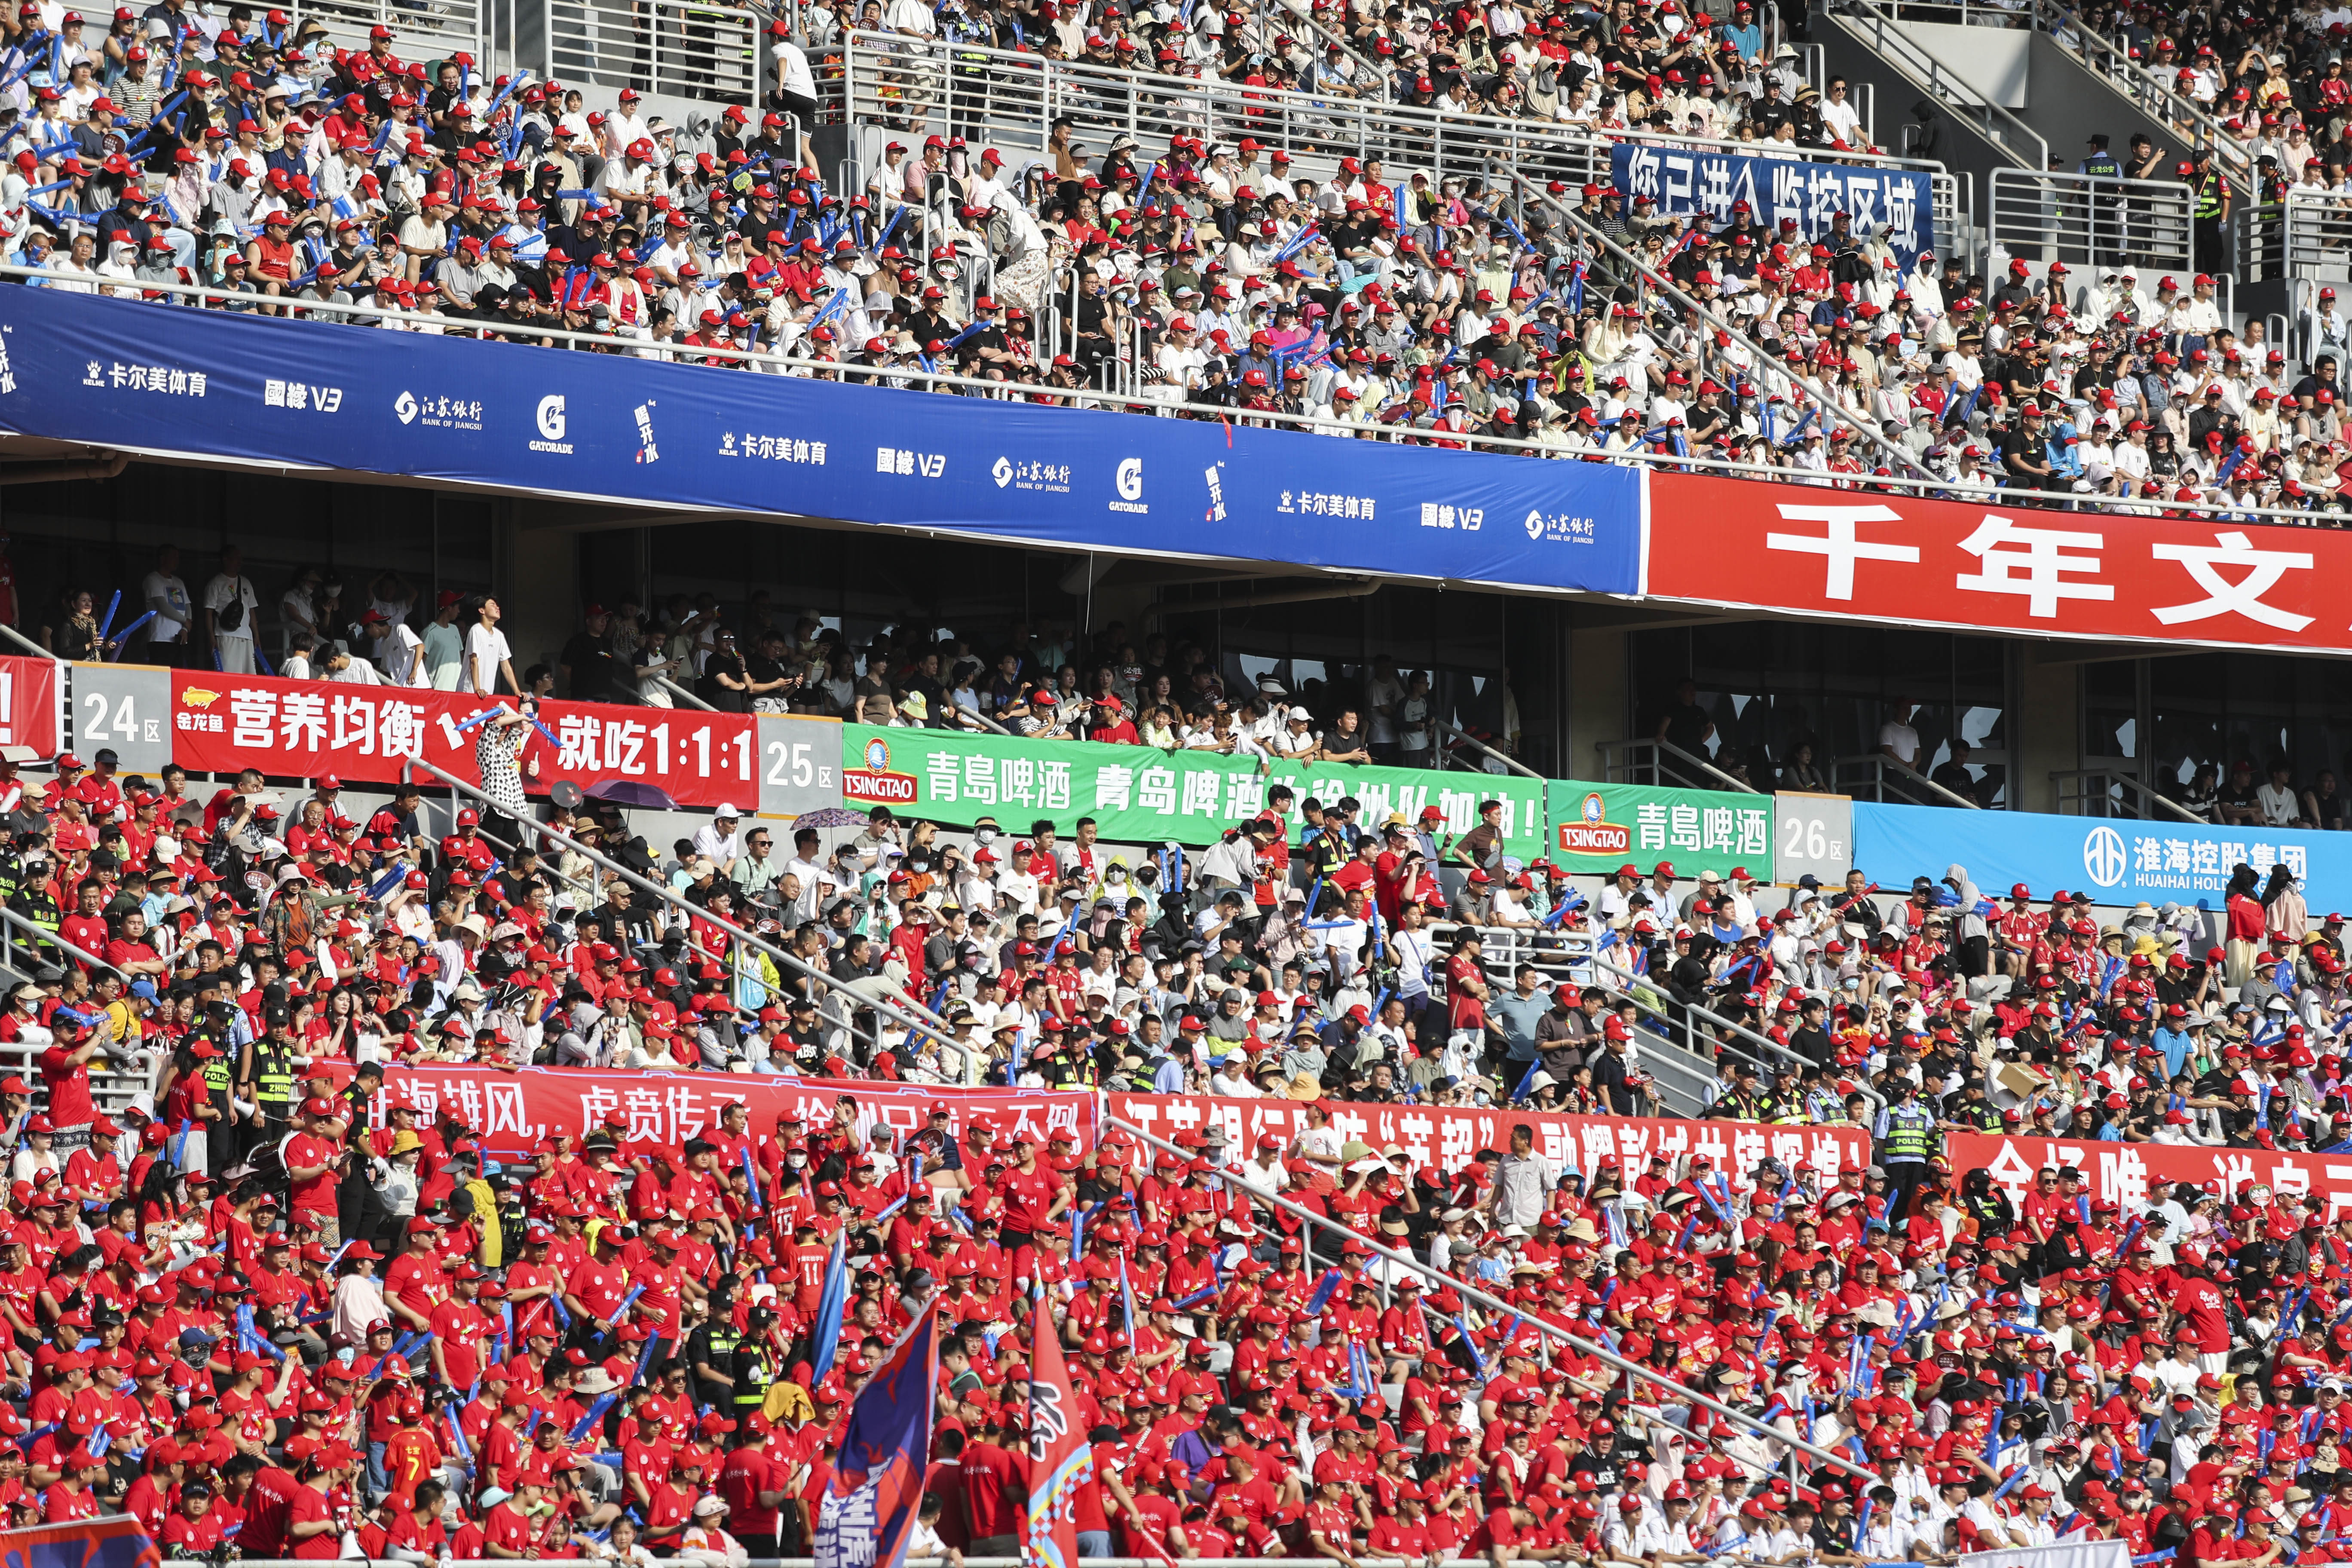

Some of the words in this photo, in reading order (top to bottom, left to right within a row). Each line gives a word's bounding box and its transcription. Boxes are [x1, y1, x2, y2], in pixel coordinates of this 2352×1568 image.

[1168, 35, 1185, 44] 必胜
[317, 45, 335, 55] 必胜
[678, 159, 695, 167] 必胜
[939, 265, 957, 274] 必胜
[0, 330, 17, 394] 开水
[2061, 364, 2075, 372] 必胜
[83, 379, 105, 387] KELME
[108, 362, 207, 397] 卡尔美体育
[311, 386, 343, 413] V3
[422, 395, 483, 421] 江苏银行
[422, 418, 441, 426] BANK
[455, 421, 482, 431] JIANGSU
[634, 404, 659, 464] 喝开水
[529, 440, 573, 454] GATORADE
[719, 449, 738, 457] KELME
[741, 433, 827, 466] 卡尔美体育
[918, 453, 946, 478] V3
[1016, 461, 1071, 485] 江苏银行
[1045, 484, 1070, 493] JIANGSU
[1205, 466, 1227, 522] 喝开水
[1109, 501, 1148, 514] GATORADE
[1297, 491, 1375, 521] 卡尔美体育
[1459, 508, 1484, 531] V3
[1547, 514, 1595, 537] 江苏银行
[1573, 536, 1594, 545] JIANGSU
[1767, 503, 2352, 632] 千年文
[176, 712, 224, 733] 金龙鱼
[230, 688, 425, 758] 营养均衡
[844, 774, 913, 799] TSINGTAO
[1636, 802, 1767, 855] 青島啤酒
[1562, 828, 1626, 849] TSINGTAO
[2133, 836, 2307, 881] 淮海控股集团
[2135, 873, 2190, 889] HUAIHAI
[1059, 989, 1075, 1000] 徐州
[205, 1072, 230, 1082] POLIC
[1896, 1119, 1923, 1129] 警察
[1896, 1137, 1924, 1146] POLICE
[2250, 1187, 2270, 1198] 必胜
[1018, 1194, 1037, 1207] 徐州
[804, 1262, 819, 1286] 11
[605, 1289, 621, 1303] 徐州
[459, 1335, 476, 1348] 徐州
[244, 1425, 260, 1438] 徐州
[405, 1446, 420, 1455] 七宝
[407, 1456, 420, 1481] 7
[647, 1470, 662, 1485] 徐州
